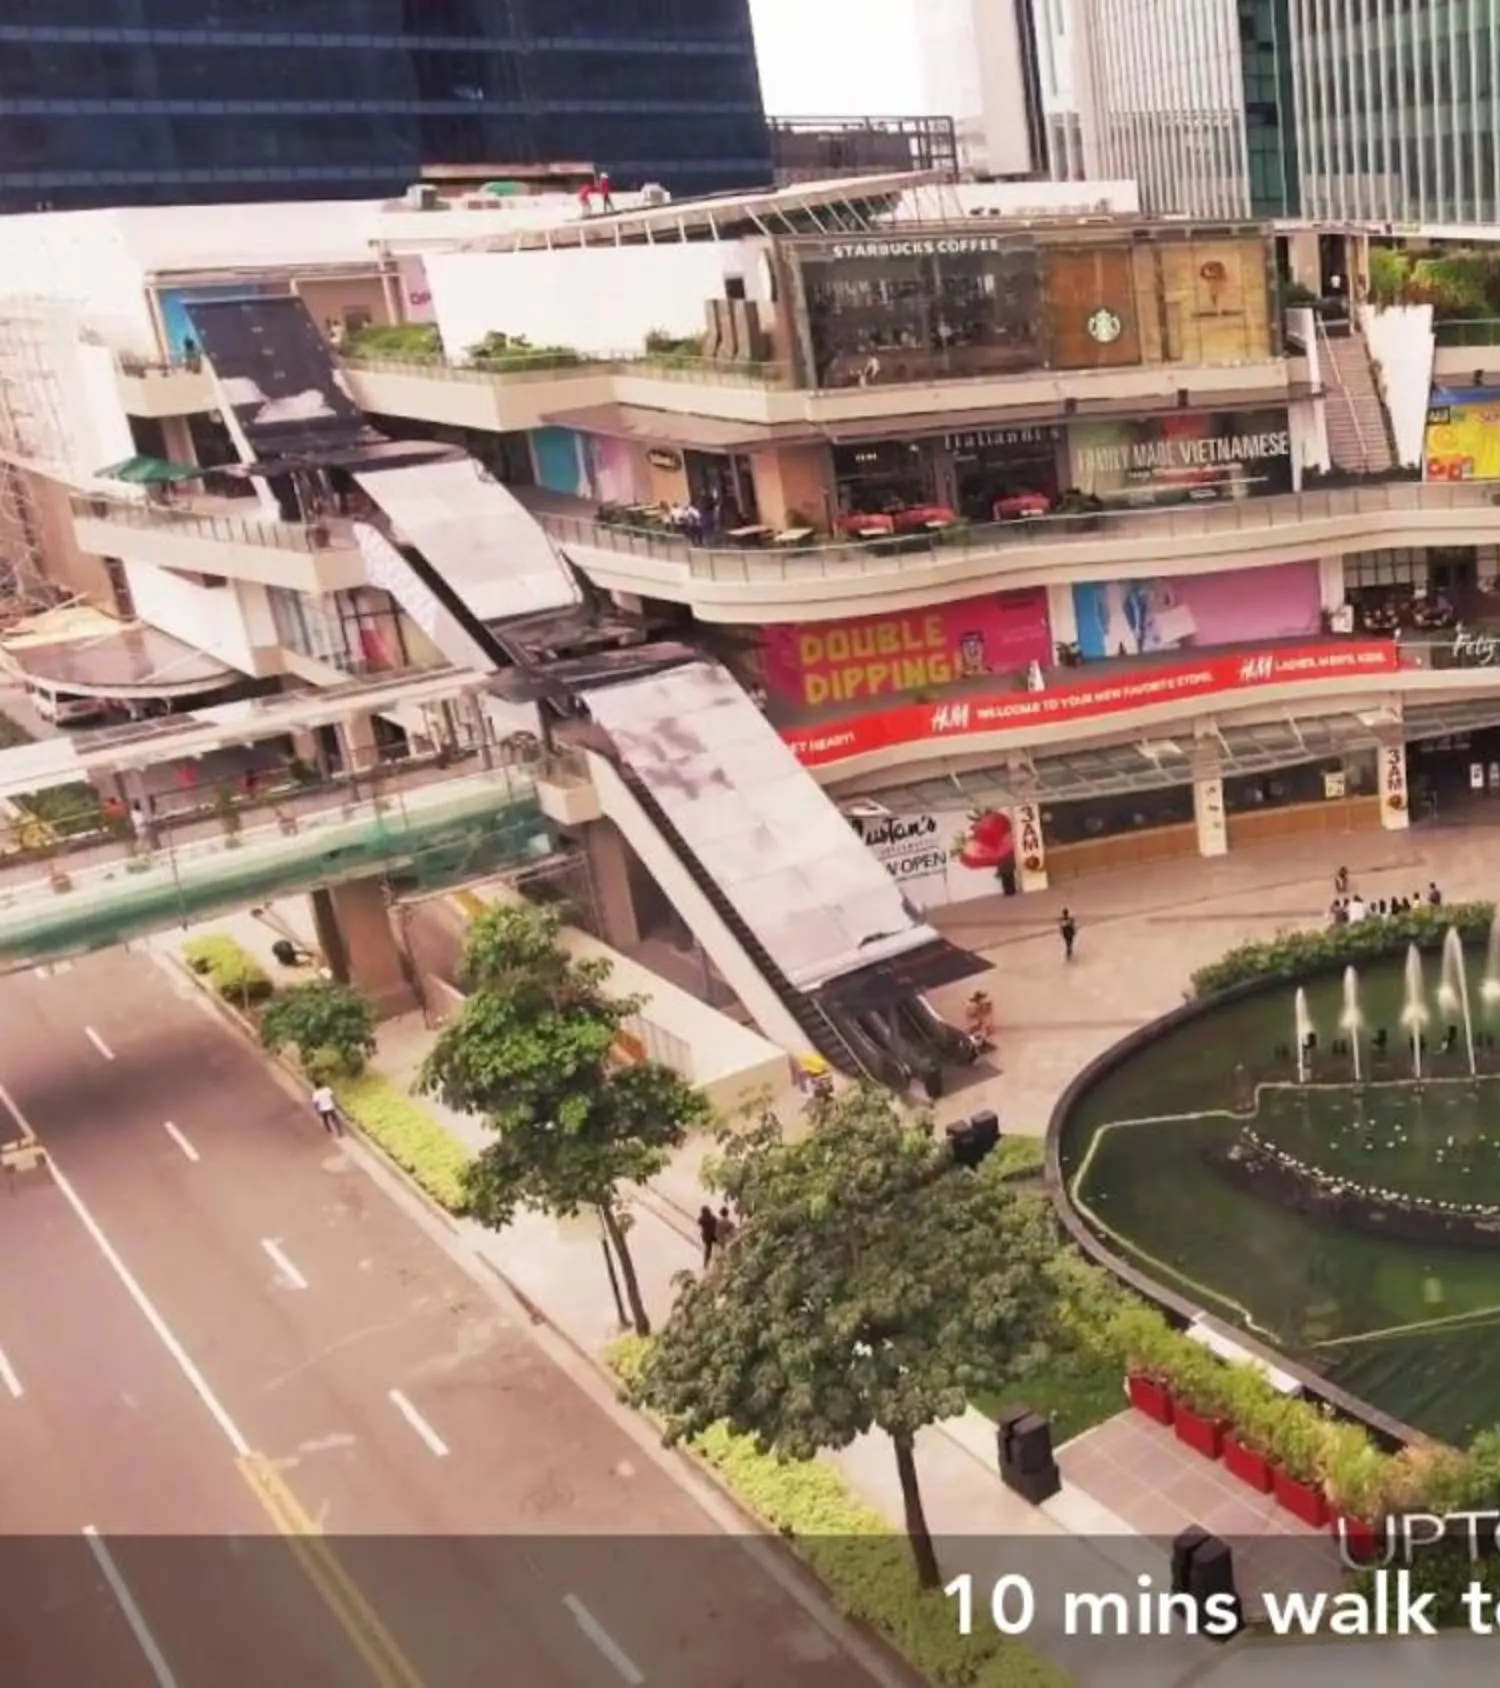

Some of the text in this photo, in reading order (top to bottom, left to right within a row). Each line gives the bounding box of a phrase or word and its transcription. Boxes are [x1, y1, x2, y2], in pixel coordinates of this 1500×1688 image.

[833, 238, 999, 258] STARBUCKS COFFEE
[1178, 431, 1289, 465] VIETNAMESE
[800, 614, 948, 666] DOUBLE
[803, 652, 964, 705] DIPPING!
[1239, 655, 1273, 682] H&M
[932, 704, 969, 731] H&M
[977, 702, 1040, 720] WELCOME
[1043, 699, 1058, 711] TO
[1060, 694, 1093, 710] YOUR
[1094, 690, 1122, 703] NEW
[1124, 679, 1175, 700] FAVORITE
[901, 852, 947, 874] OPEN
